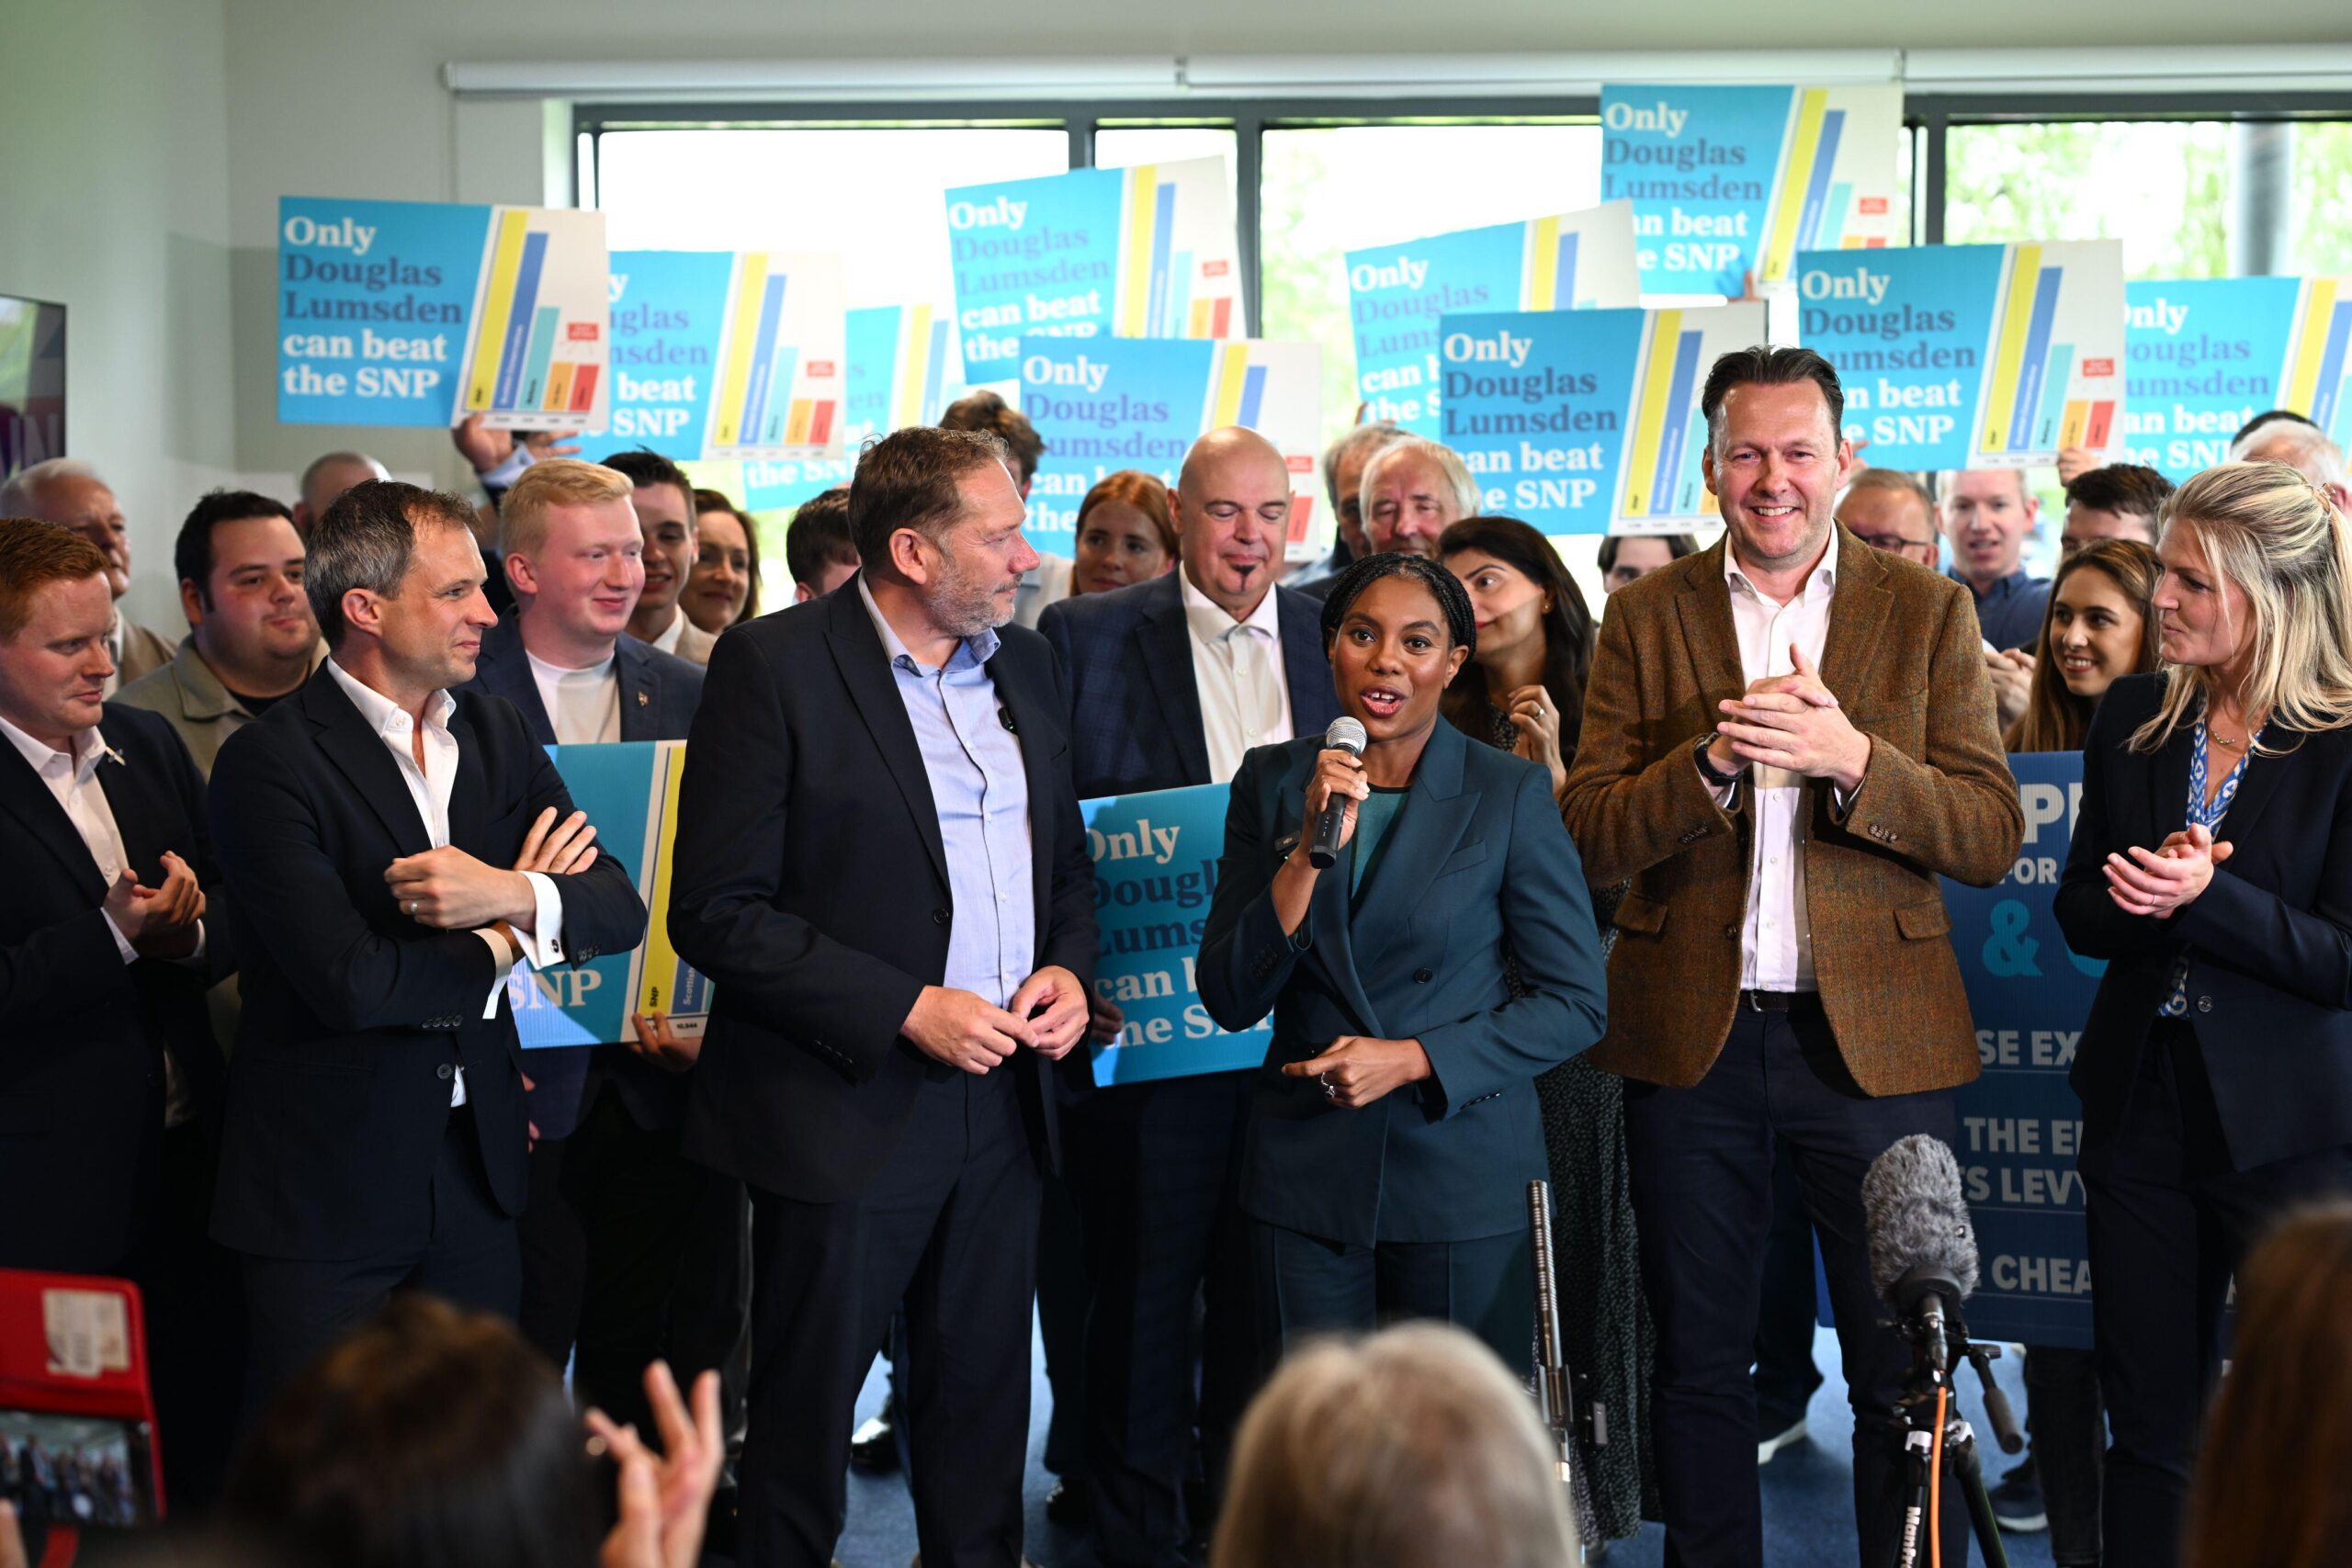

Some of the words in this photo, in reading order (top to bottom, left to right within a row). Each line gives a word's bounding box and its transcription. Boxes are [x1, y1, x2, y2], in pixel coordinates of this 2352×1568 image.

[1606, 101, 1689, 139] Only
[1606, 138, 1747, 172] Douglas
[1604, 173, 1763, 202] Lumsden
[948, 195, 1028, 231] Only
[1671, 206, 1749, 237] beat
[283, 216, 377, 255] Only
[953, 226, 1090, 265] Douglas
[284, 253, 444, 293] Douglas
[1351, 256, 1430, 292] Only
[1663, 242, 1741, 272] SNP
[958, 258, 1111, 298] Lumsden
[1801, 266, 1891, 306] Only
[284, 290, 464, 325] Lumsden
[961, 302, 1022, 331] can
[1025, 288, 1101, 323] beat
[1353, 281, 1491, 325] Douglas
[1803, 303, 1957, 342] Douglas
[282, 333, 354, 359] can
[361, 328, 448, 363] beat
[965, 332, 1020, 363] the
[1443, 331, 1532, 367] Only
[1829, 340, 1976, 372] umsden
[2125, 333, 2251, 368] ouglas
[282, 364, 348, 397] the
[355, 367, 441, 399] SNP
[617, 371, 697, 402] beat
[1023, 355, 1109, 392] Only
[1362, 364, 1421, 393] can
[1446, 367, 1598, 403] Douglas
[2126, 370, 2269, 398] umsden
[1366, 396, 1421, 423] the
[1877, 378, 1962, 409] beat
[613, 407, 691, 437] SNP
[1025, 392, 1169, 432] Douglas
[1446, 403, 1618, 436] Lumsden
[1048, 430, 1187, 458] umsden
[1872, 414, 1955, 446] SNP
[1520, 440, 1604, 472] beat
[1515, 478, 1597, 511] SNP
[1025, 501, 1079, 532] the
[509, 968, 602, 1011] SNP
[649, 986, 661, 1008] SNP
[1095, 969, 1175, 1002] can
[1963, 1117, 2041, 1154] THE
